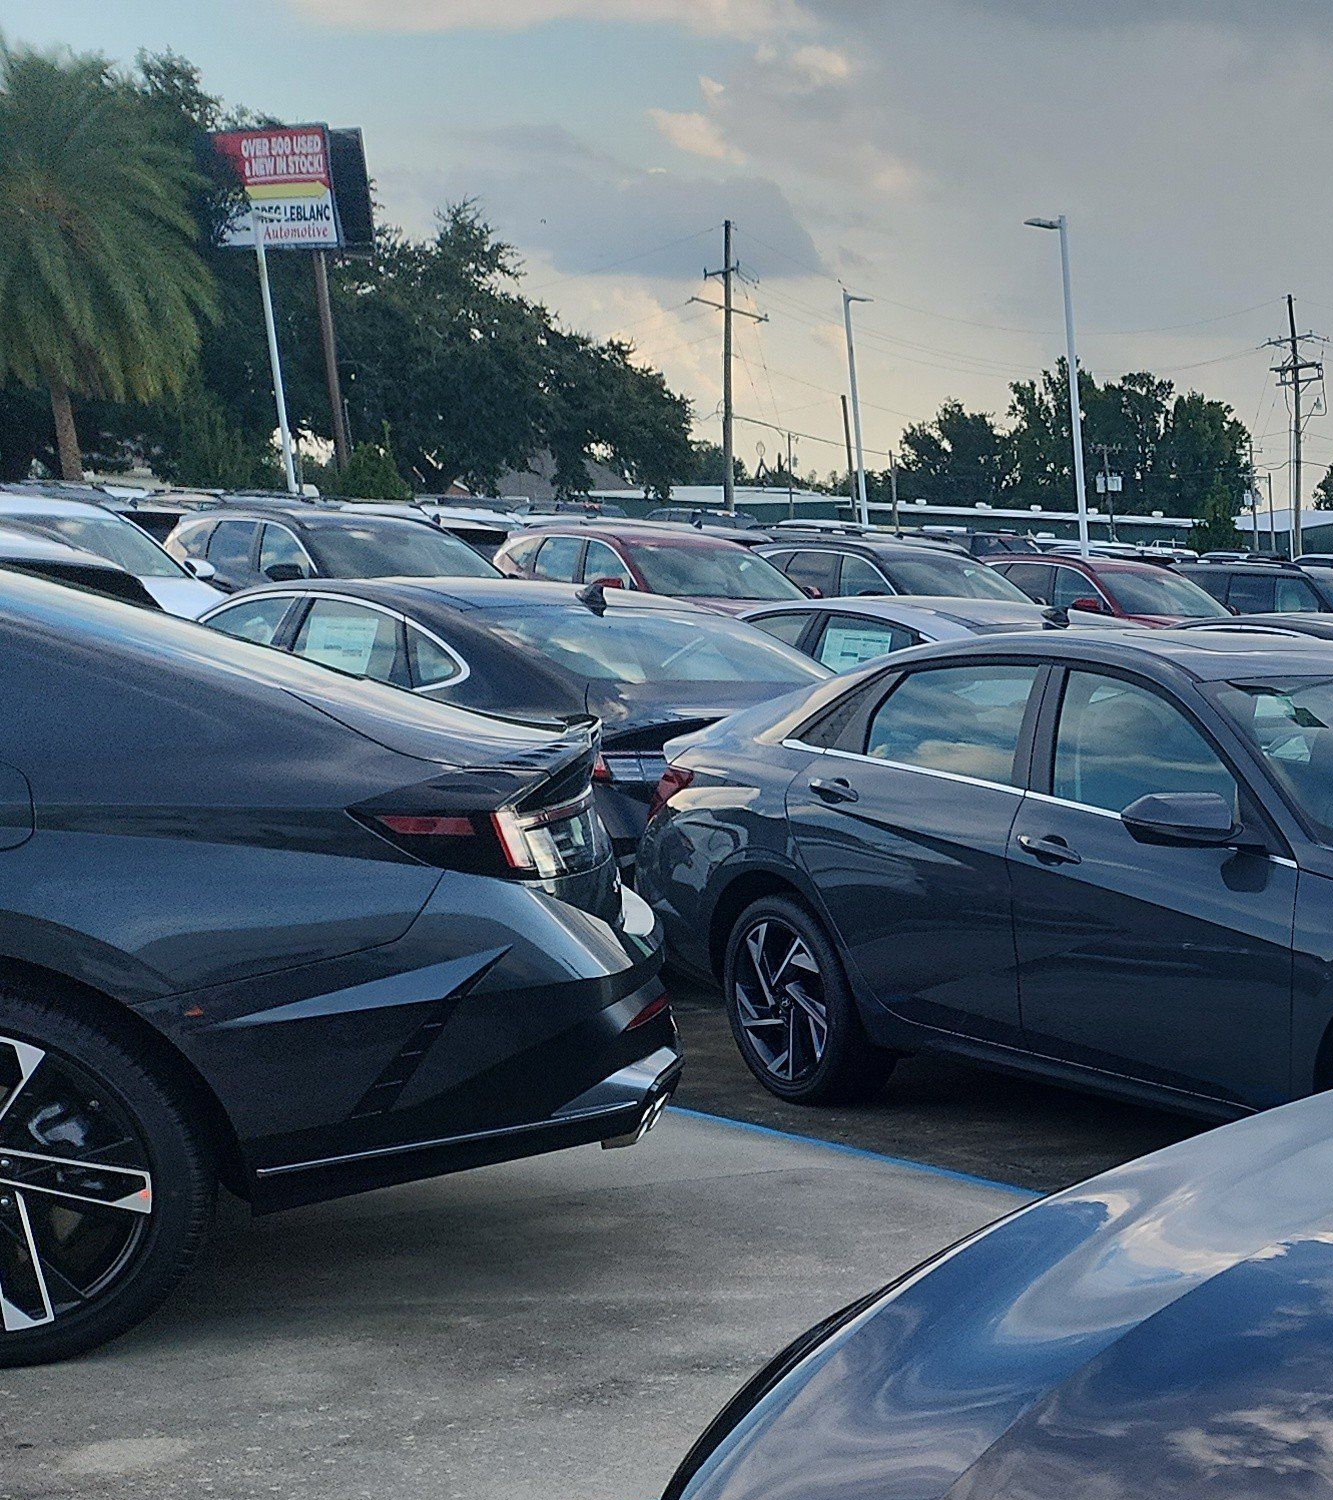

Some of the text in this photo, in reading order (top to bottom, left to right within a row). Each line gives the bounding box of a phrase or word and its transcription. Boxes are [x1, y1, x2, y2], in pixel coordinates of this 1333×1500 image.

[241, 138, 270, 158] OVER
[293, 134, 322, 153] USED
[252, 157, 275, 176] NEW
[276, 156, 288, 175] IN
[284, 204, 331, 221] LEBLANC
[264, 222, 328, 240] Automotive
